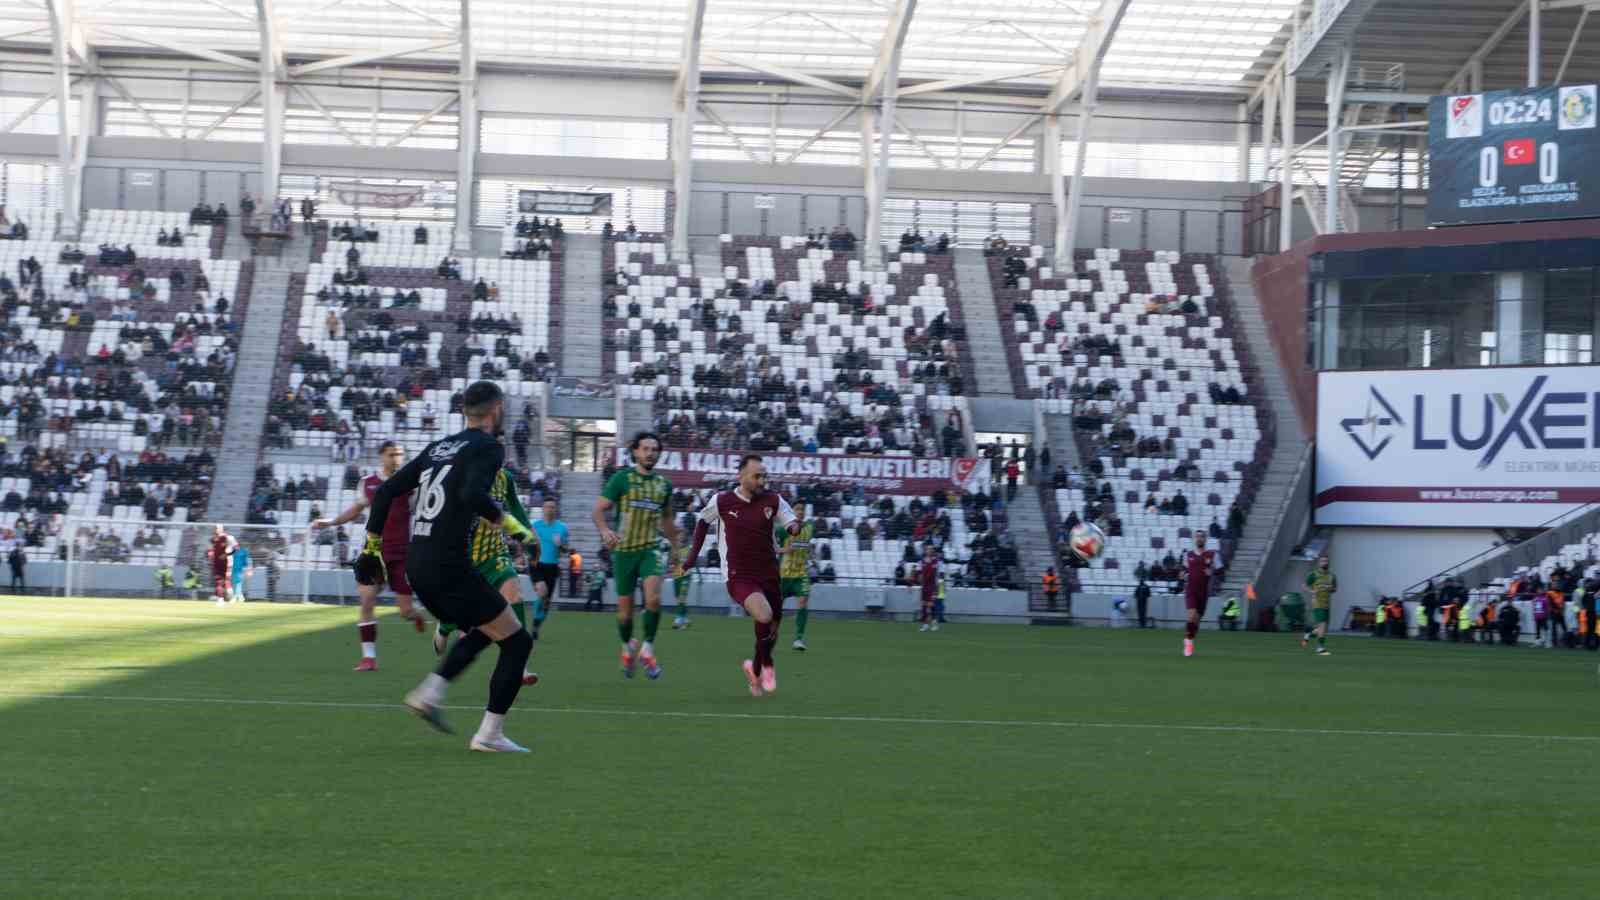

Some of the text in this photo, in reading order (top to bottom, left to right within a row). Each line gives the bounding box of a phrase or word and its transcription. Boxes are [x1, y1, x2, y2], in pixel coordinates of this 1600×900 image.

[1489, 98, 1552, 125] 02:24
[1480, 146, 1499, 187] 0
[1539, 142, 1559, 184] 0
[1413, 375, 1600, 469] LUXE
[687, 452, 741, 474] KALE
[762, 456, 822, 475] RKASI
[415, 464, 453, 520] 16
